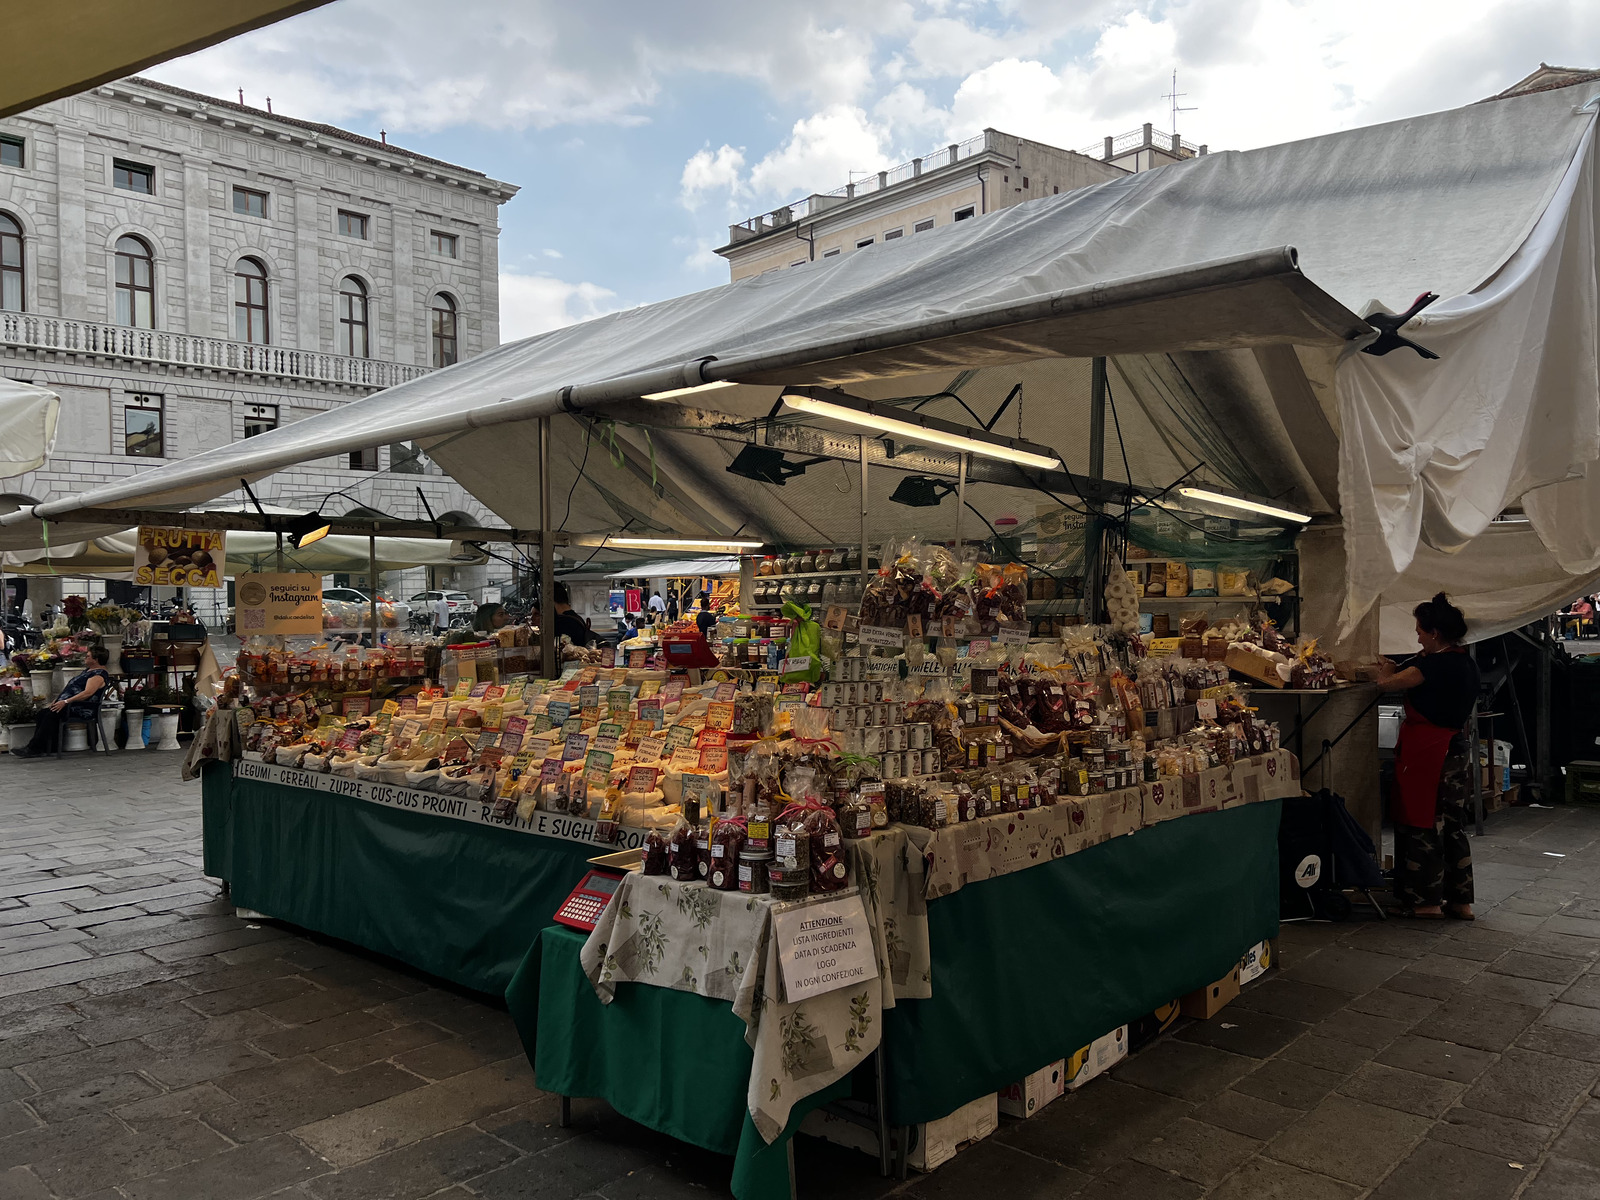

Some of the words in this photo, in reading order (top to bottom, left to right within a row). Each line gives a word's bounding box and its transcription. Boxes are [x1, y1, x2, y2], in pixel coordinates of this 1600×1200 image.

[139, 527, 223, 551] FRUTTA
[136, 565, 220, 588] SECCA
[270, 584, 299, 593] seguici
[269, 592, 319, 606] Instagram
[240, 763, 271, 780] LEGUMI
[280, 770, 318, 788] CEREALI
[329, 778, 363, 798] ZUPPE
[371, 786, 419, 808] CUS-CUS
[422, 795, 468, 817] PRONTI
[538, 816, 547, 833] E
[800, 915, 843, 931] ATTENZIONE
[792, 935, 810, 946] LISTA
[811, 927, 854, 942] INGREDIENTI
[794, 949, 812, 960] DATA
[812, 948, 820, 956] DI
[821, 941, 857, 955] SCADENZA
[816, 958, 837, 970] LOGO
[795, 980, 803, 989] IN
[803, 976, 821, 987] OGNI
[821, 967, 864, 983] CONFEZIONE
